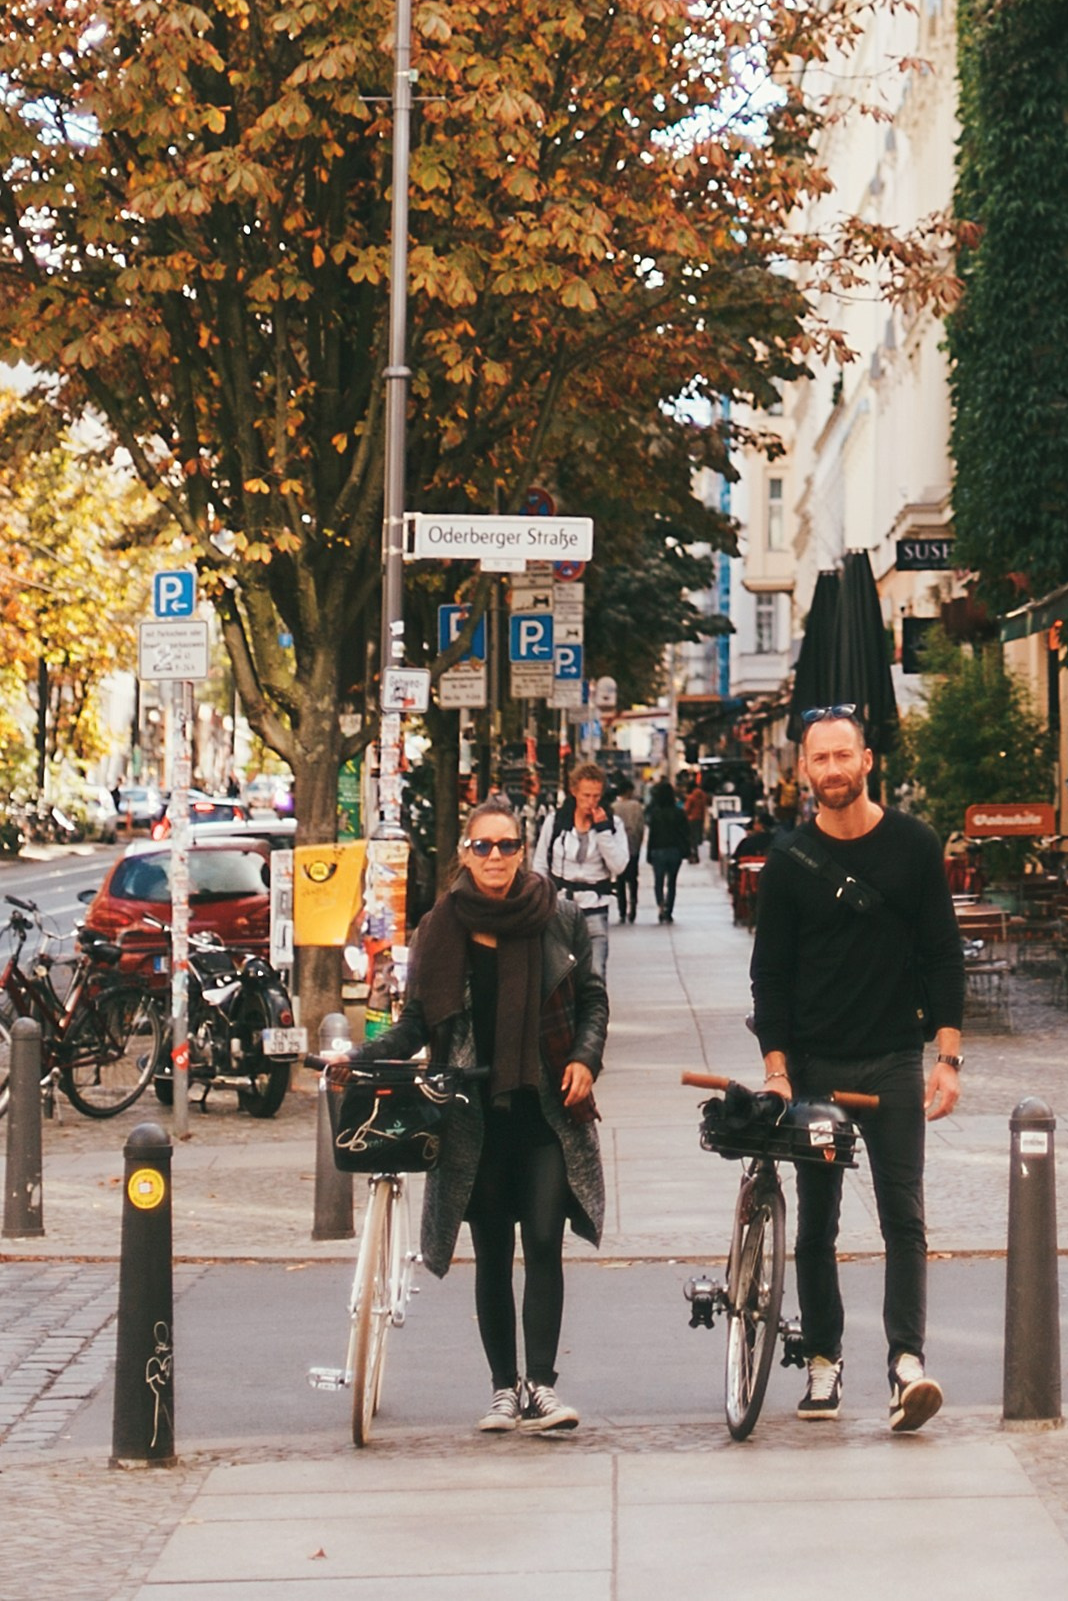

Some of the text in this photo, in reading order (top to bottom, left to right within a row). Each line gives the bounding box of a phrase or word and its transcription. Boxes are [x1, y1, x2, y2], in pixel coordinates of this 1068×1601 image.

[428, 525, 578, 549] Oderberger Straße
[160, 576, 183, 613] P
[519, 620, 544, 656] P
[555, 648, 575, 675] P
